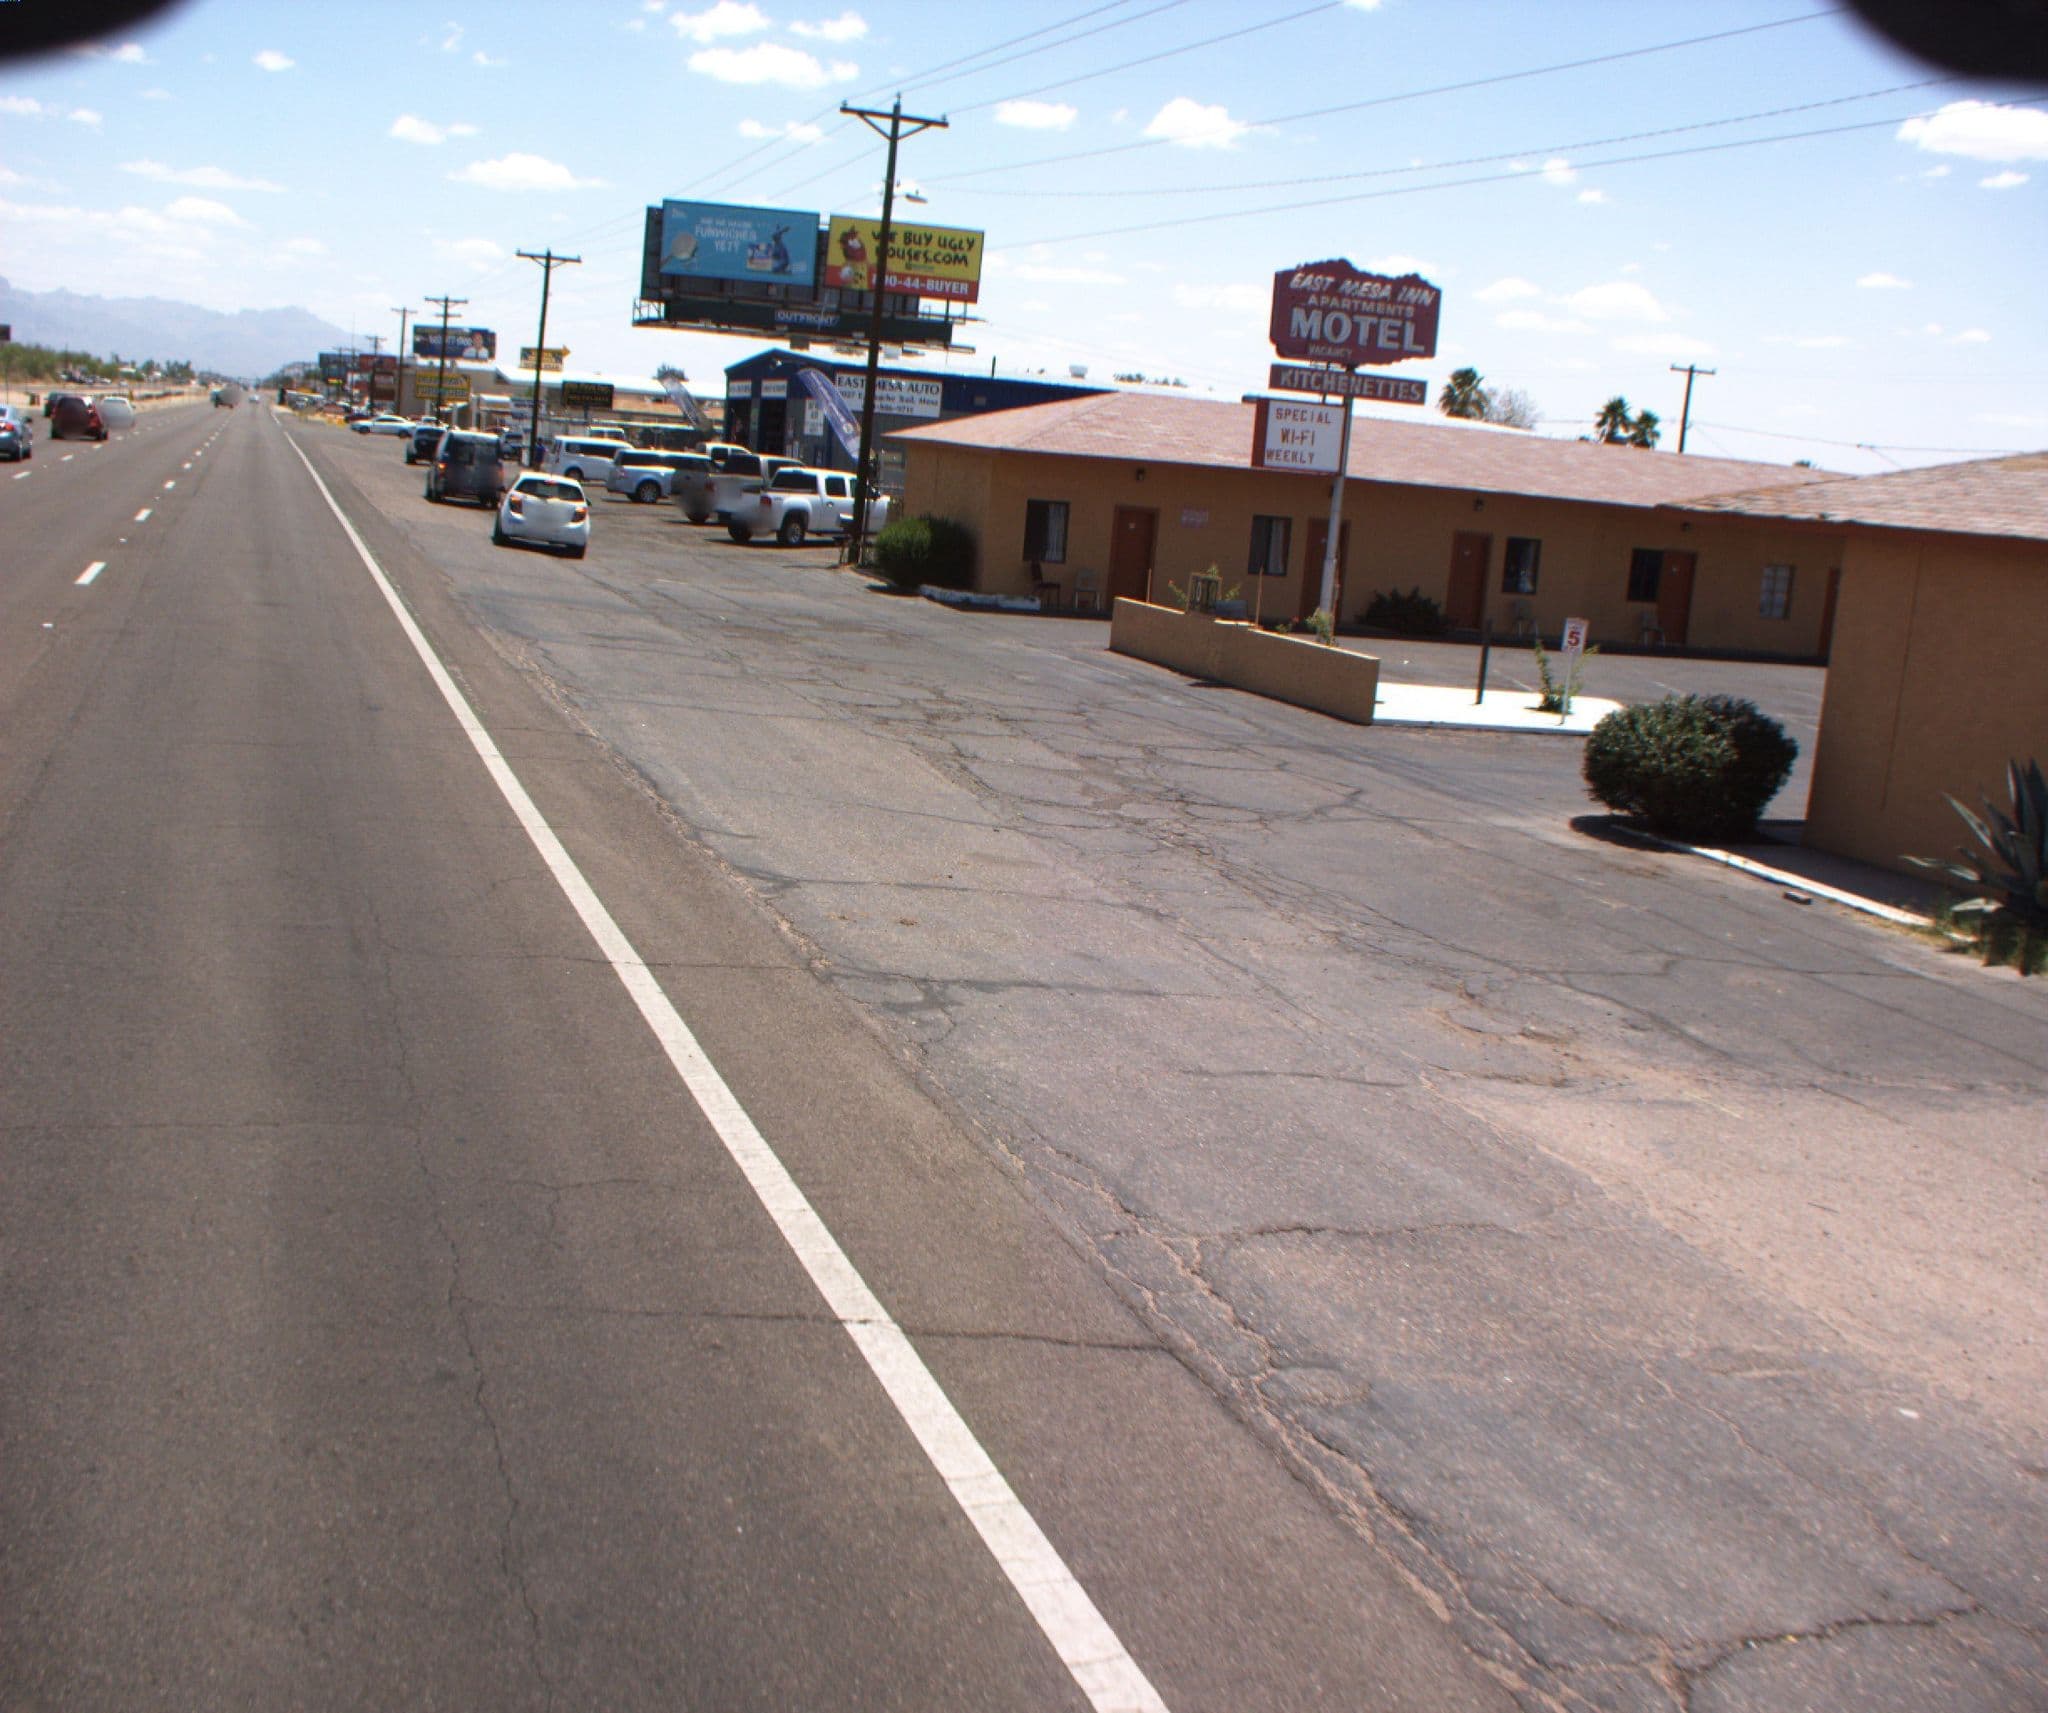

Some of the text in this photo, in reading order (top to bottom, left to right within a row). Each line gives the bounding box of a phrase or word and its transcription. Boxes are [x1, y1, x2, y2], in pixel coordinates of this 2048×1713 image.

[903, 230, 933, 246] BUY
[938, 233, 975, 251] UGLY
[1289, 272, 1435, 306] EAST MESA INN
[1307, 294, 1415, 319] APARTMENTS
[1290, 307, 1425, 353] MOTEL
[1308, 344, 1353, 358] VACANCY
[837, 375, 865, 389] EAST
[907, 382, 940, 396] AUTO
[1280, 369, 1422, 401] KITCHENETTES
[1275, 407, 1332, 424] SPECIAL
[1280, 428, 1316, 446] WI-FI
[1265, 448, 1316, 465] WEEKLY
[1567, 630, 1581, 646] 5
